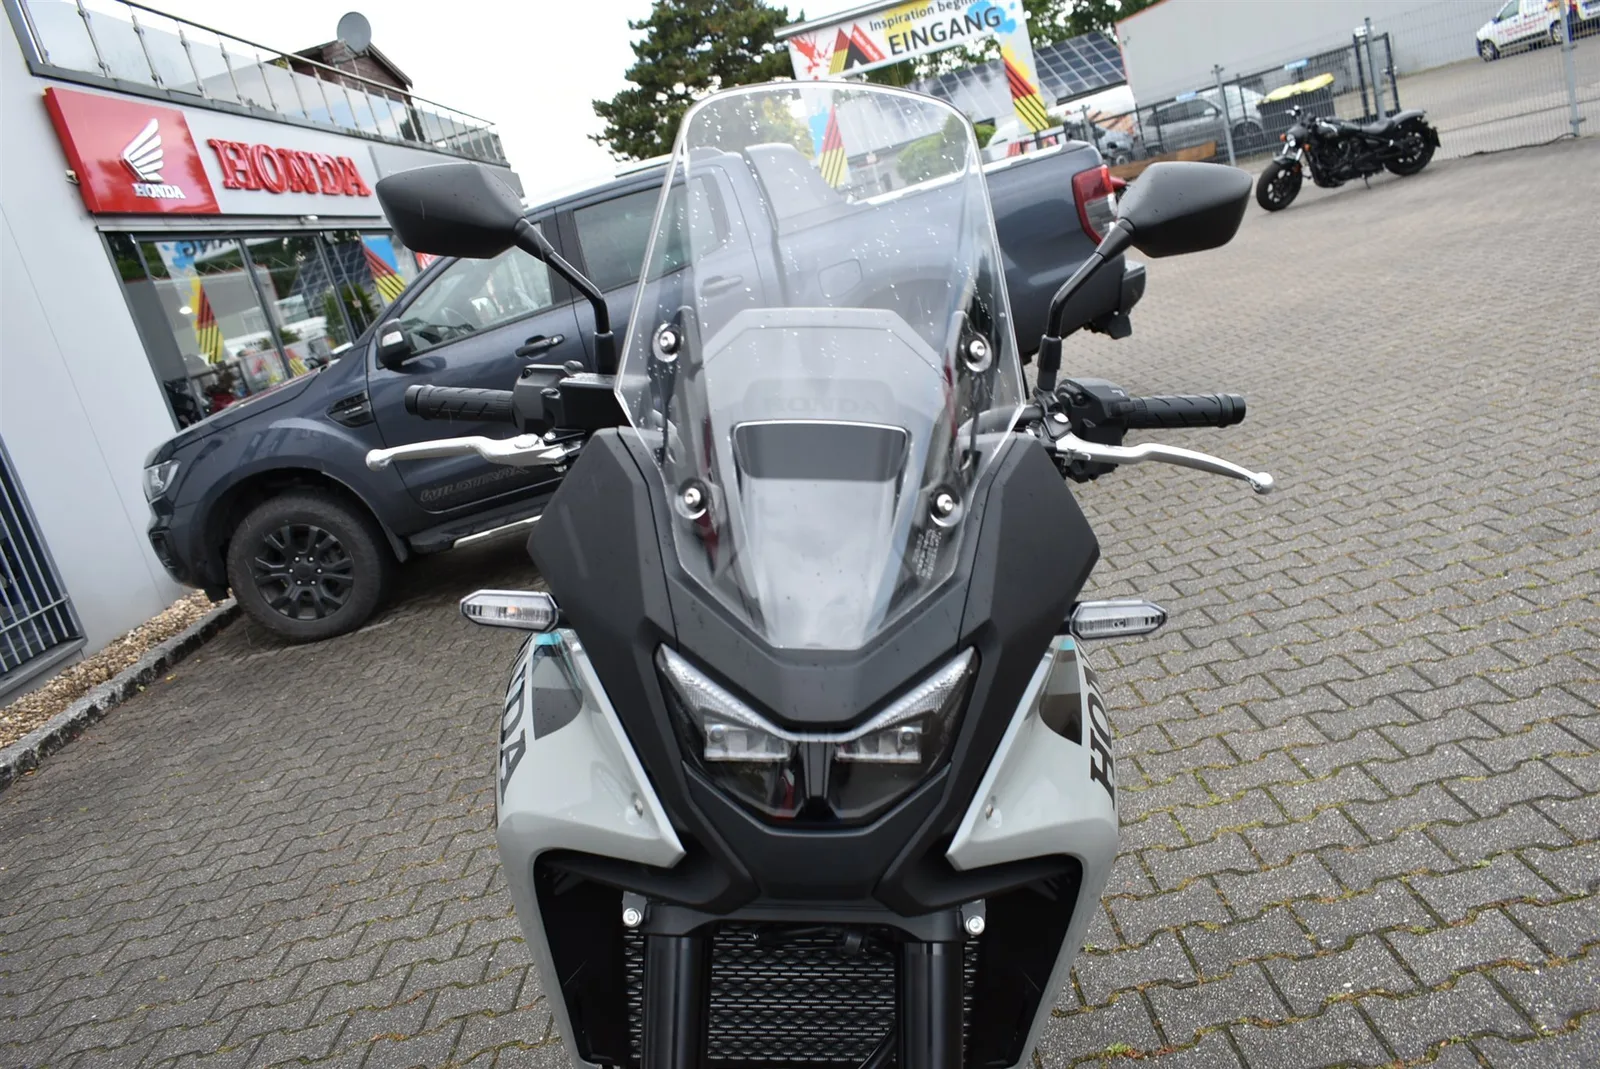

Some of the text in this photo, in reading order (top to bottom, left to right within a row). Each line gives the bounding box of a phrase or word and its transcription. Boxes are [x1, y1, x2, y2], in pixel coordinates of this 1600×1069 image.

[869, 6, 935, 31] Inspiration
[888, 7, 1001, 55] EINGANG
[207, 138, 371, 196] HONDA
[131, 183, 186, 199] HONDA
